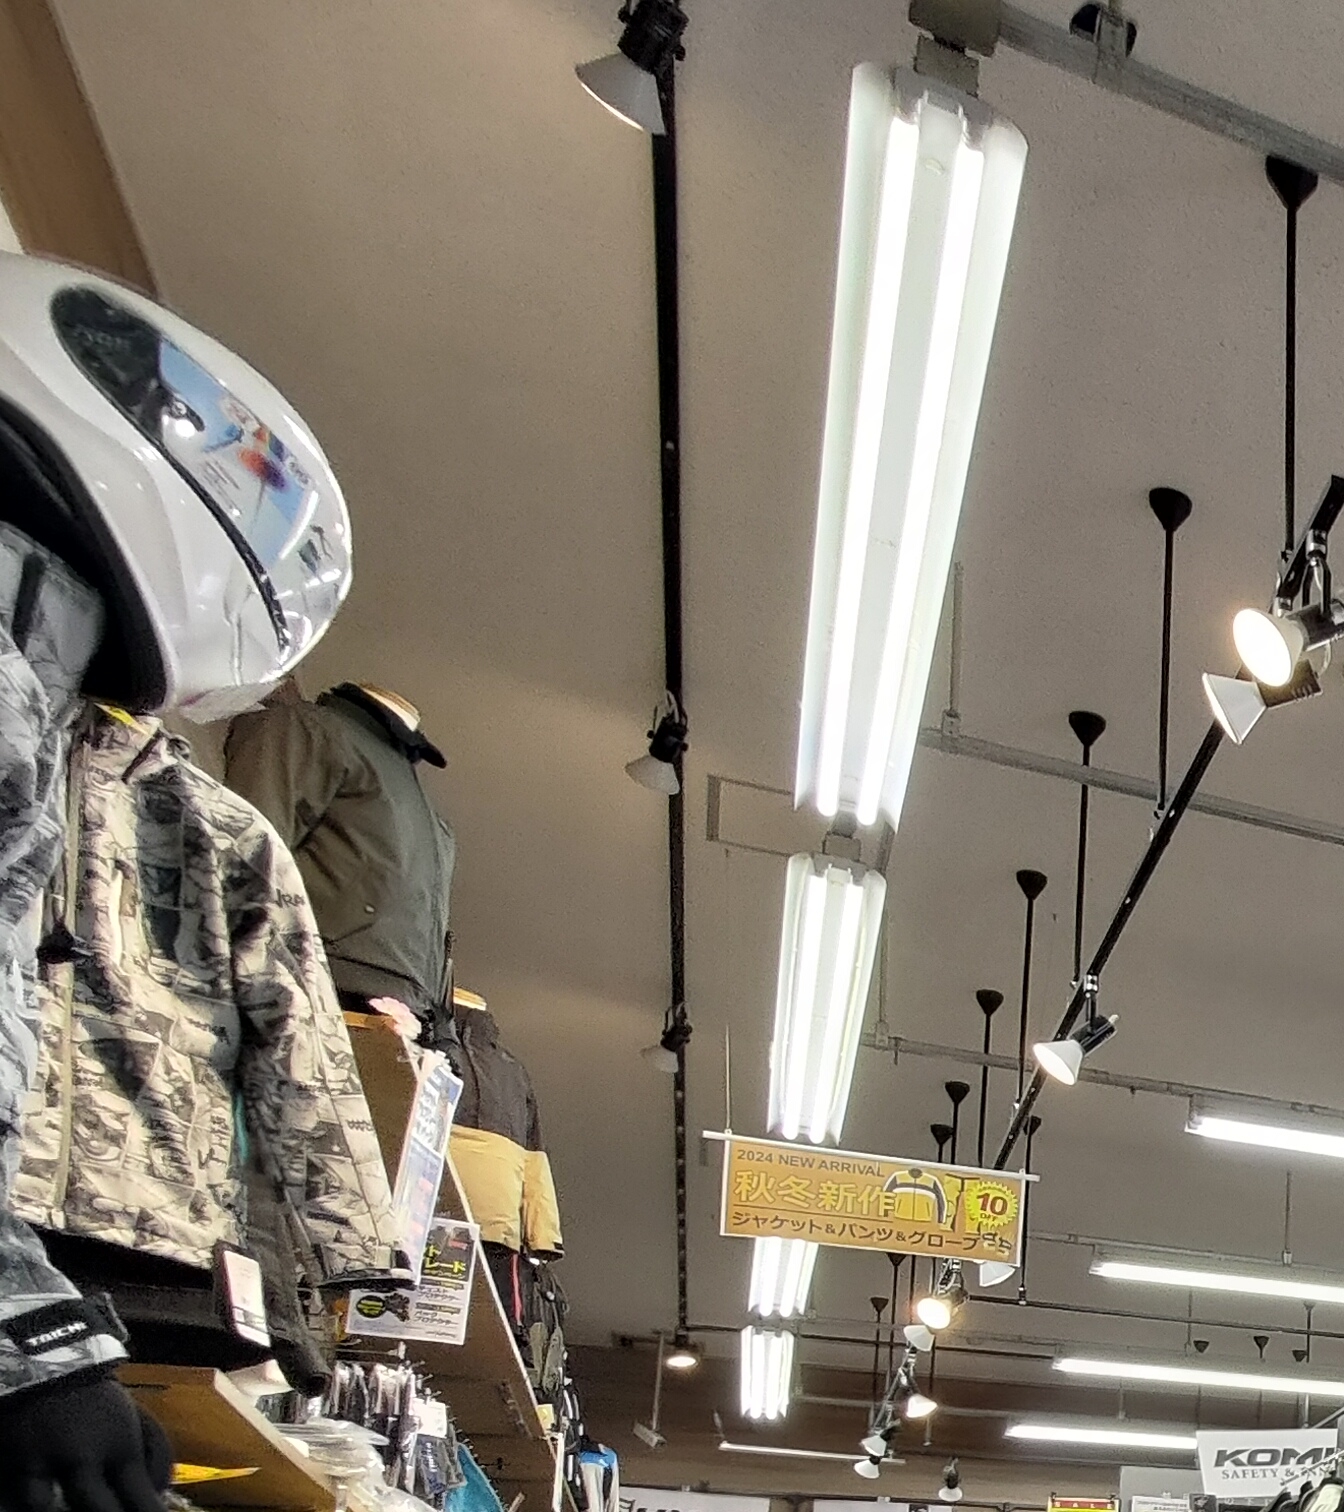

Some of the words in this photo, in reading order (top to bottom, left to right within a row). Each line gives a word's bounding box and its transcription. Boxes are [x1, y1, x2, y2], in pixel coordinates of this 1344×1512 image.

[737, 1150, 774, 1163] 2024
[778, 1154, 814, 1168] NEW
[818, 1159, 886, 1178] ARRIVAL
[734, 1169, 897, 1218] 秋冬新作
[976, 1192, 1008, 1216] 10
[1221, 1468, 1279, 1480] SAFETY
